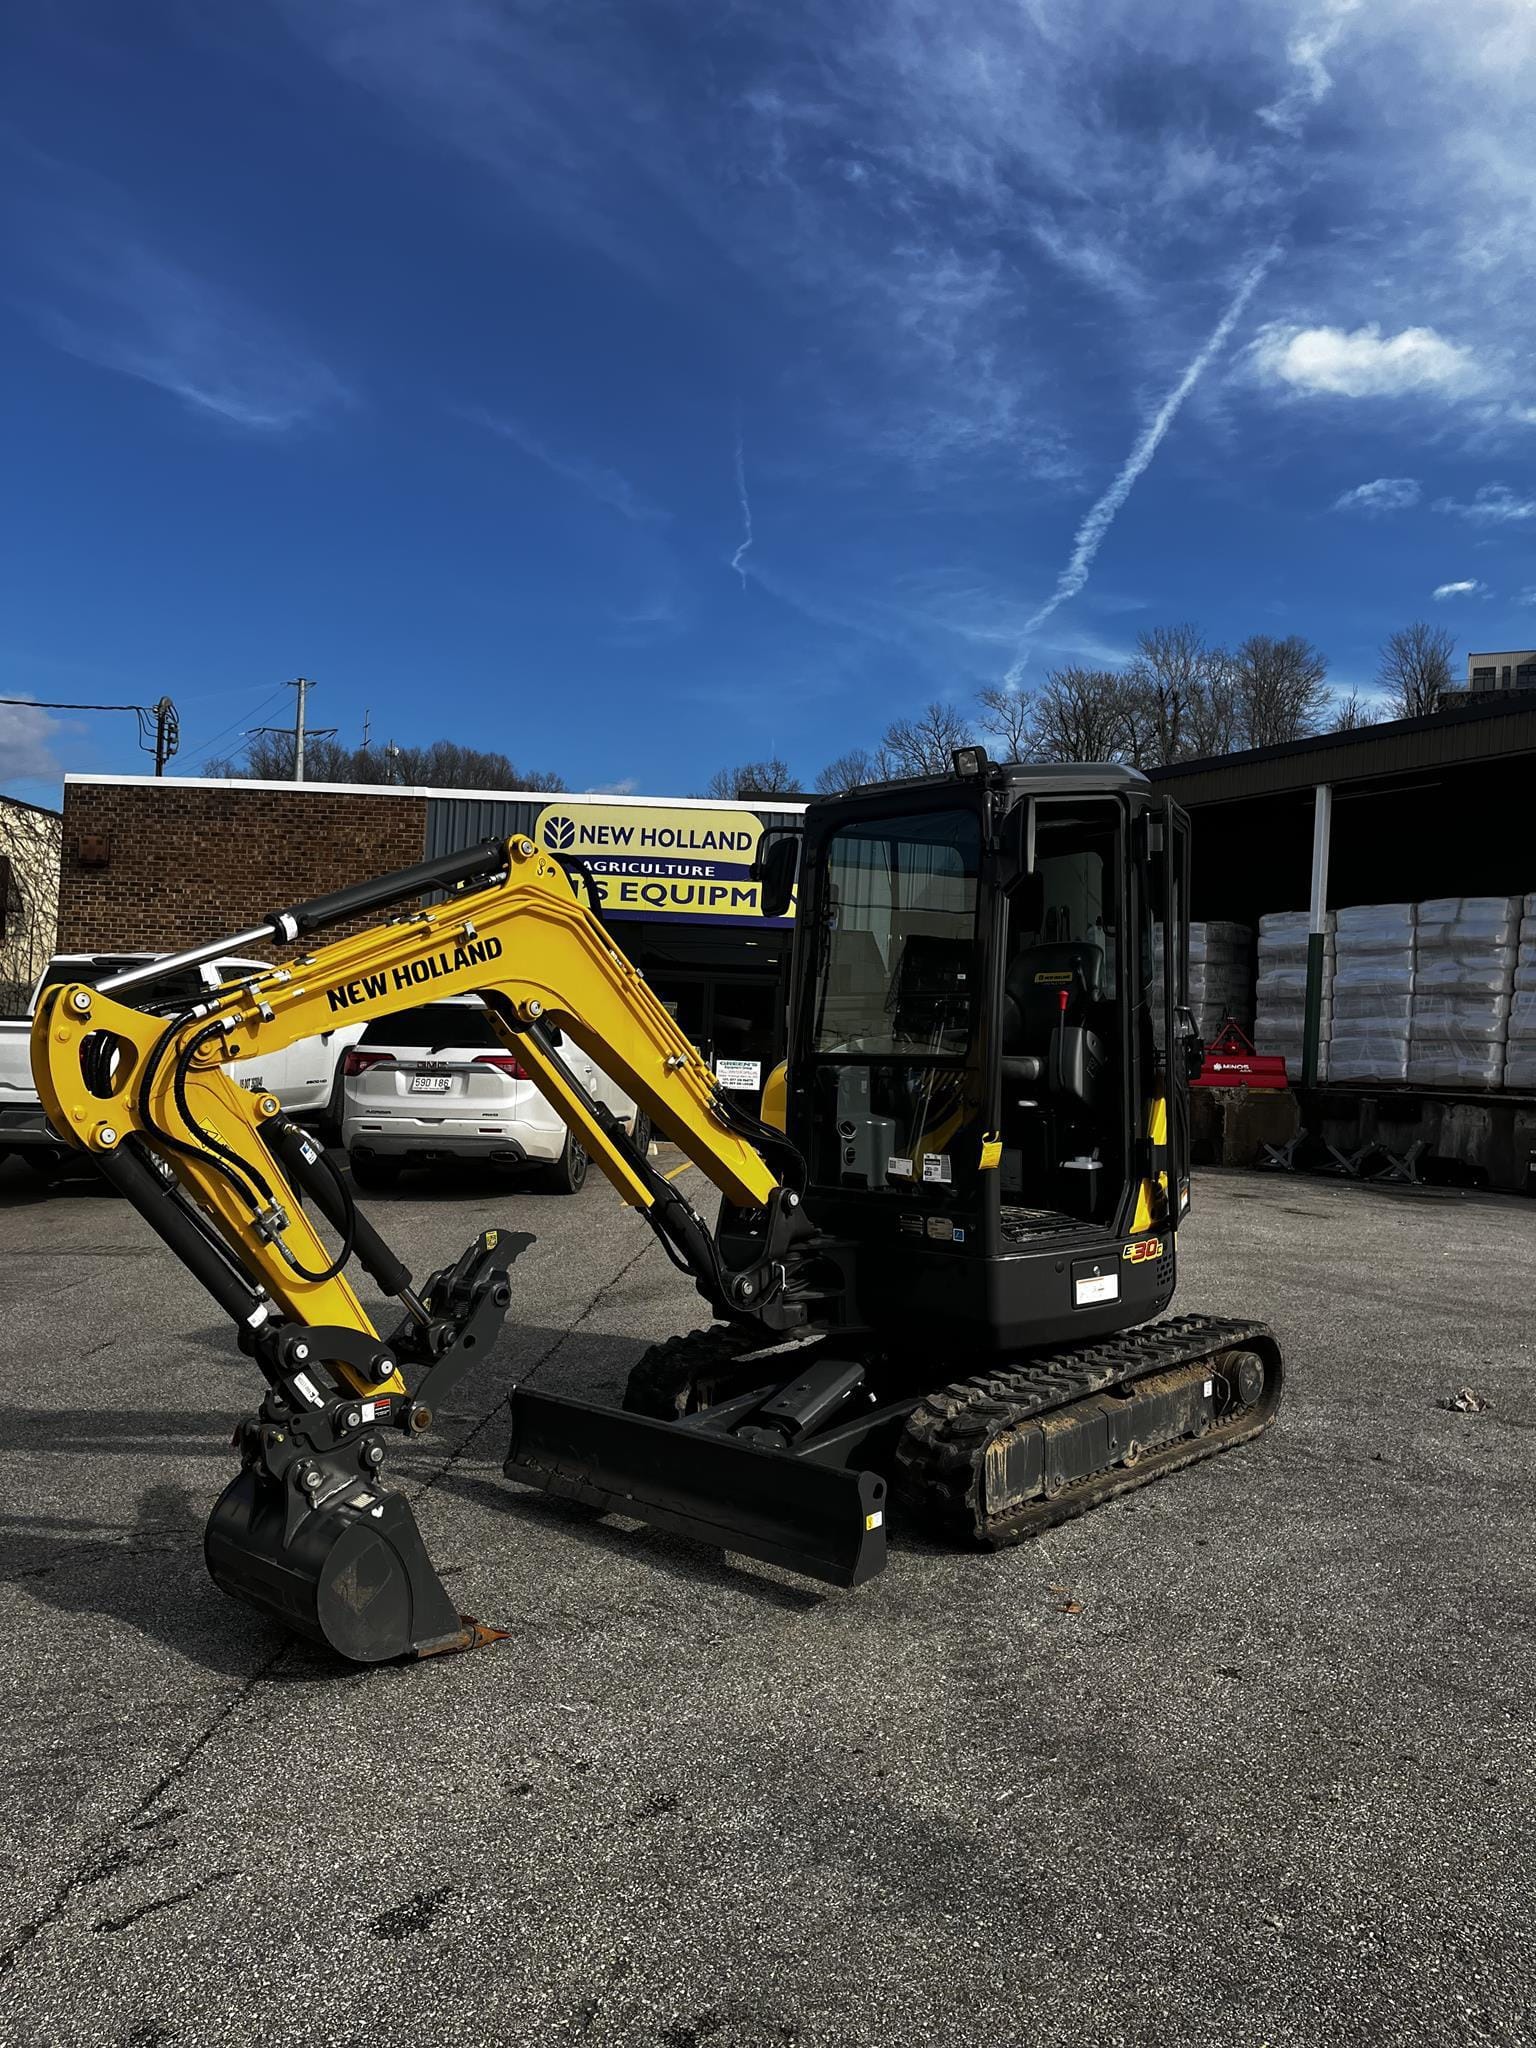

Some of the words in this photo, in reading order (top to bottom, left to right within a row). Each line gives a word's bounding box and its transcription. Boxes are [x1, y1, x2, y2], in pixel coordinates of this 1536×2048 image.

[580, 825, 635, 845] NEW
[640, 827, 753, 851] HOLLAND
[583, 860, 716, 877] AGRICULTURE
[620, 881, 797, 908] EQUIPM
[326, 972, 388, 1012] NEW
[391, 936, 503, 991] HOLLAND
